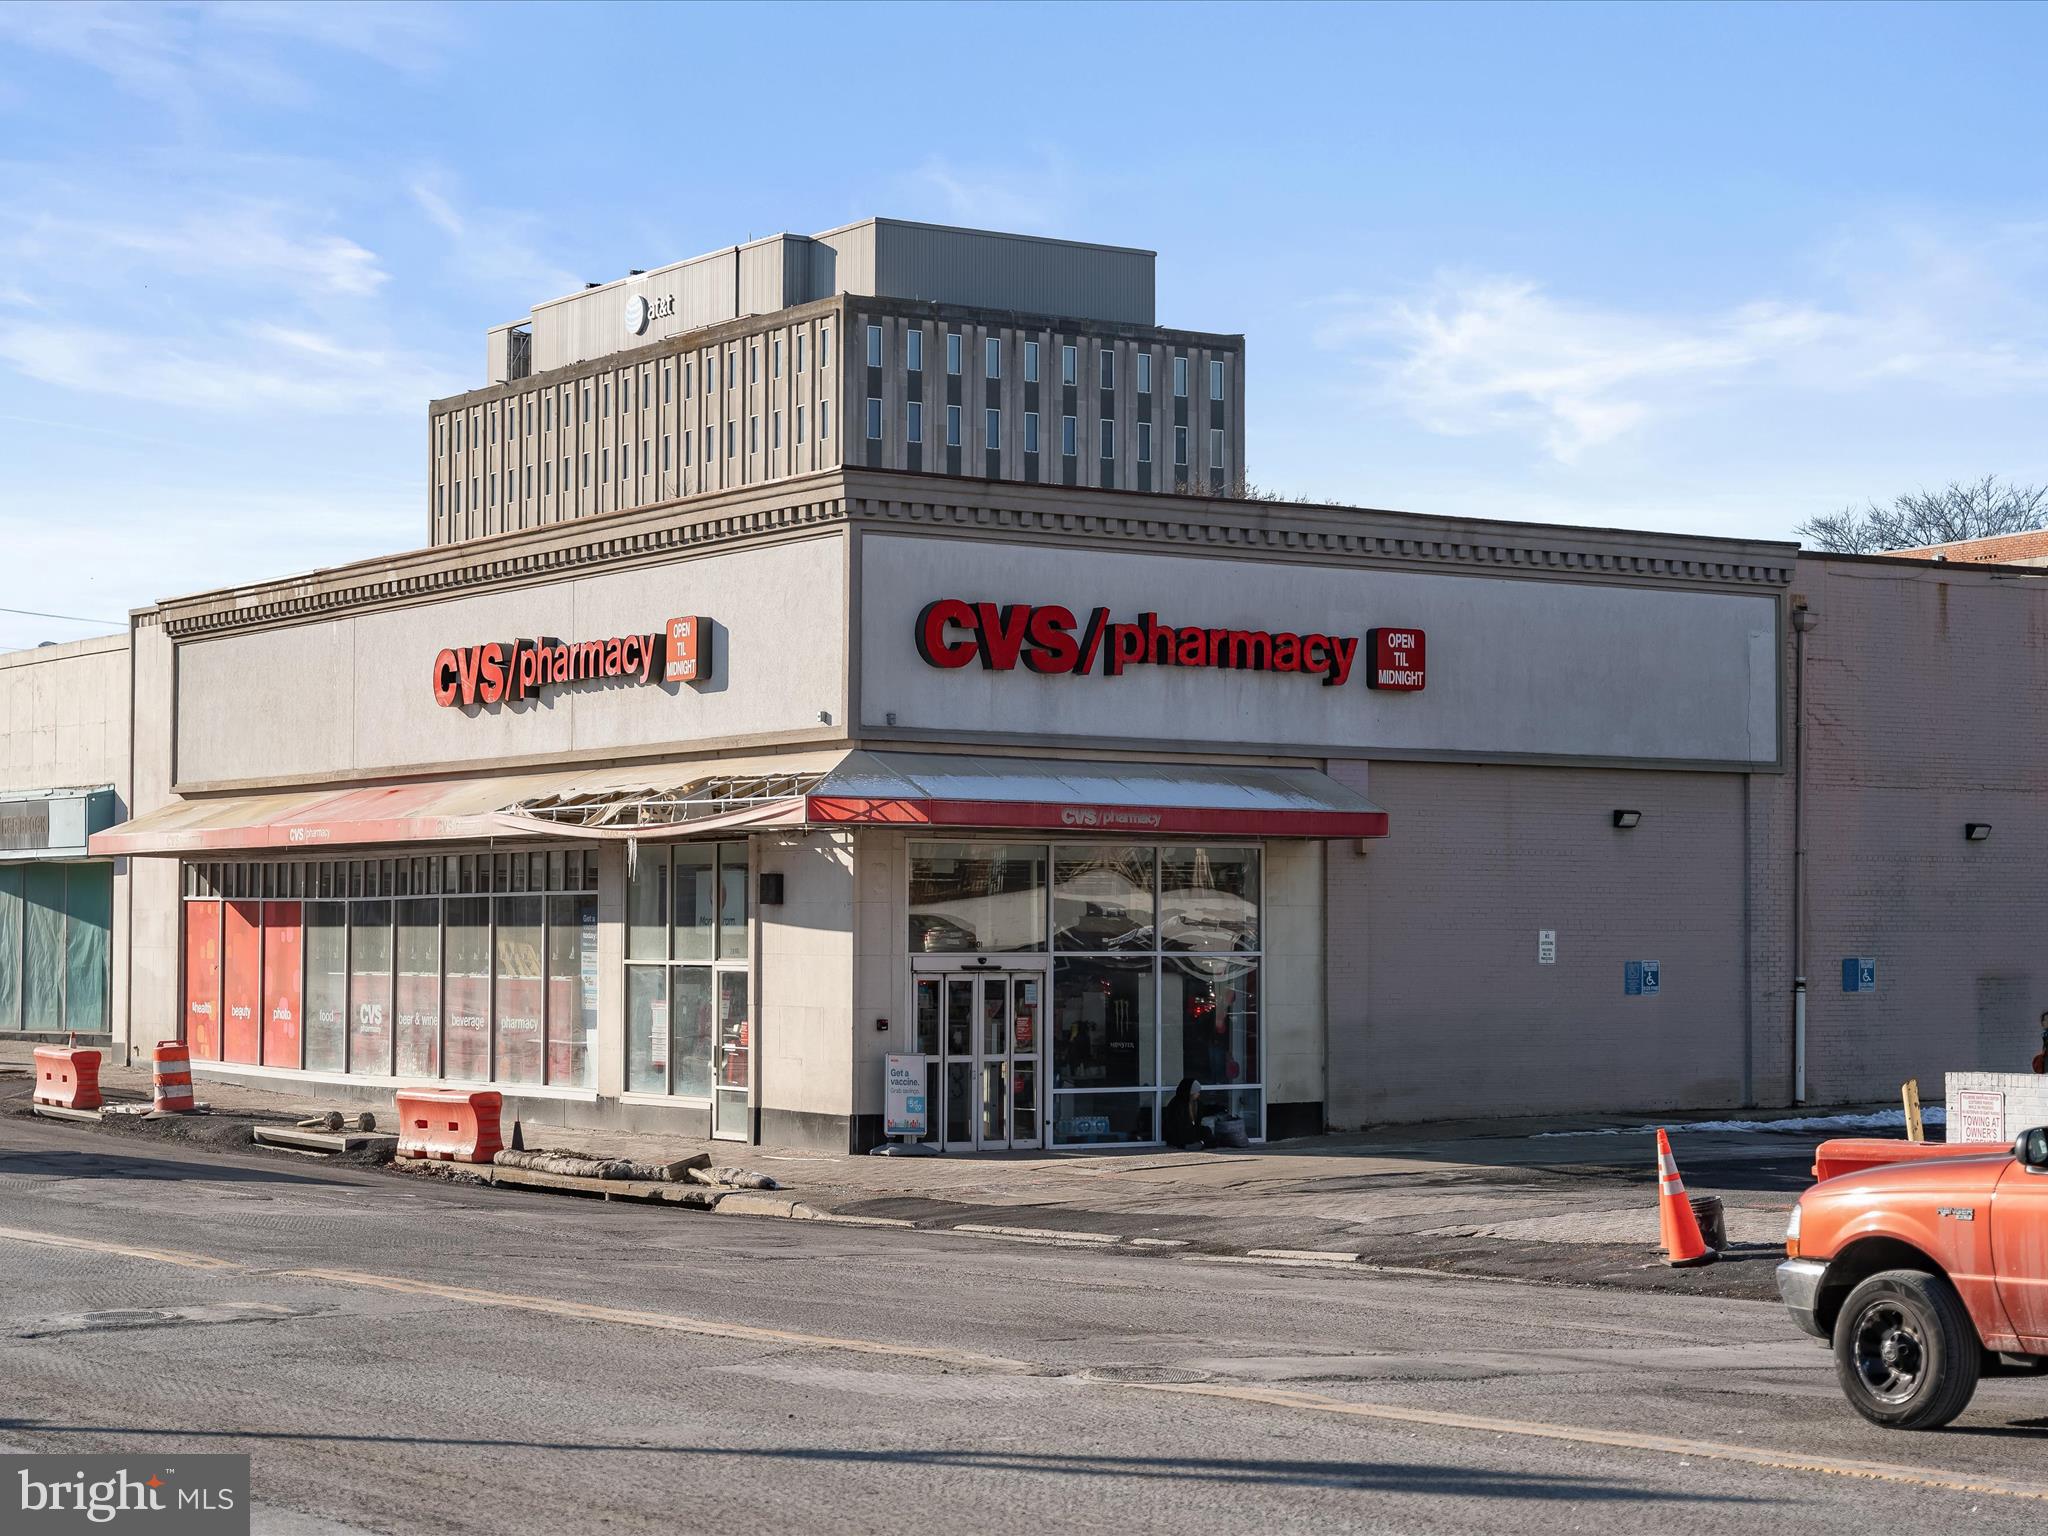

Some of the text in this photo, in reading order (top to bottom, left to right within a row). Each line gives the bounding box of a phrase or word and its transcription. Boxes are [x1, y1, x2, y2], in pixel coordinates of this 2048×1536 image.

[647, 294, 674, 320] at&t
[673, 622, 691, 639] OPEN
[916, 599, 1359, 686] CVS/pharmacy
[1388, 632, 1415, 649] OPEN
[433, 633, 657, 708] CVS/pharmacy
[666, 658, 697, 677] MIDNIGHT
[1378, 669, 1424, 686] MIDNIGHT
[273, 1007, 292, 1021] photo
[319, 1009, 334, 1023] food
[360, 1003, 382, 1025] CVS
[398, 1012, 414, 1025] beer
[421, 1013, 438, 1026] wine
[451, 1013, 485, 1031] beverage
[501, 1015, 539, 1032] pharmacy
[890, 1068, 904, 1077] Get
[890, 1078, 920, 1086] vaccine.
[1963, 1115, 2001, 1128] TOWING AT
[1966, 1127, 1998, 1139] OWNER'S
